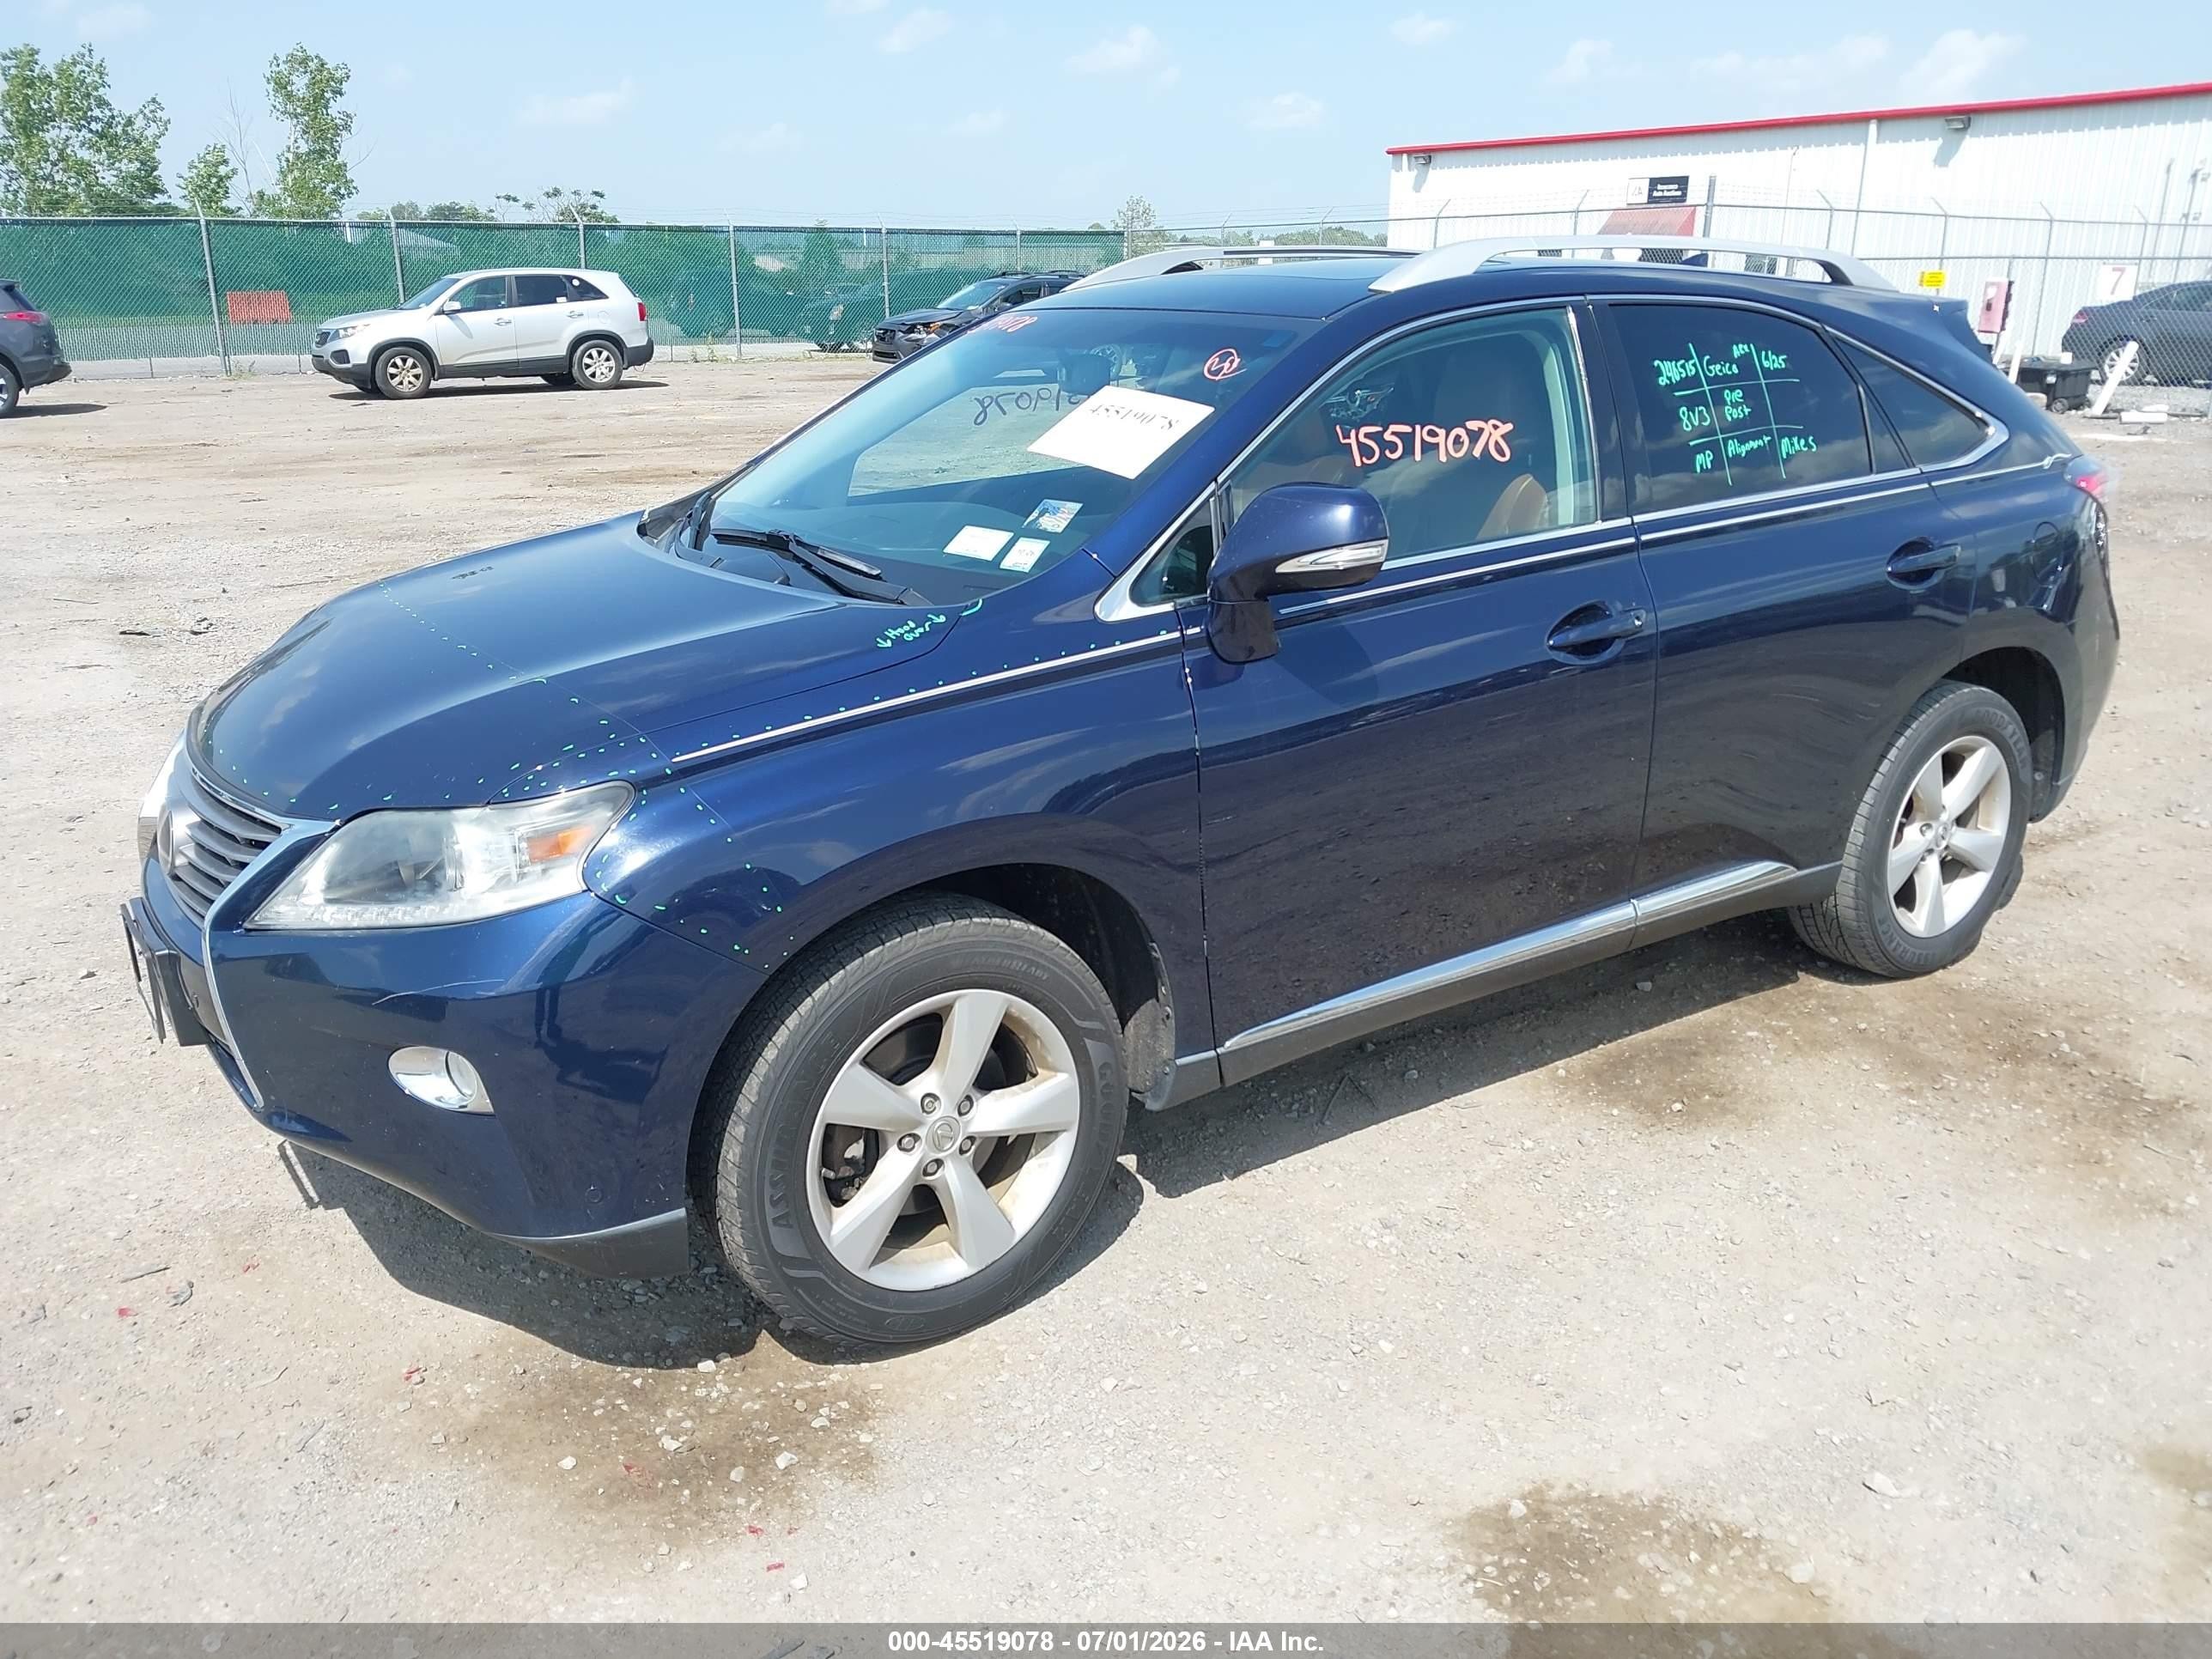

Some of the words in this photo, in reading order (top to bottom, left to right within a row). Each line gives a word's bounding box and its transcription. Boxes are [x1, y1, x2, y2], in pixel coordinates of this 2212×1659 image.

[2110, 267, 2126, 295] 7
[1703, 355, 1739, 376] Geico
[1761, 350, 1787, 369] 6/25
[1335, 418, 1514, 466] 45519078
[1695, 450, 1714, 473] MP
